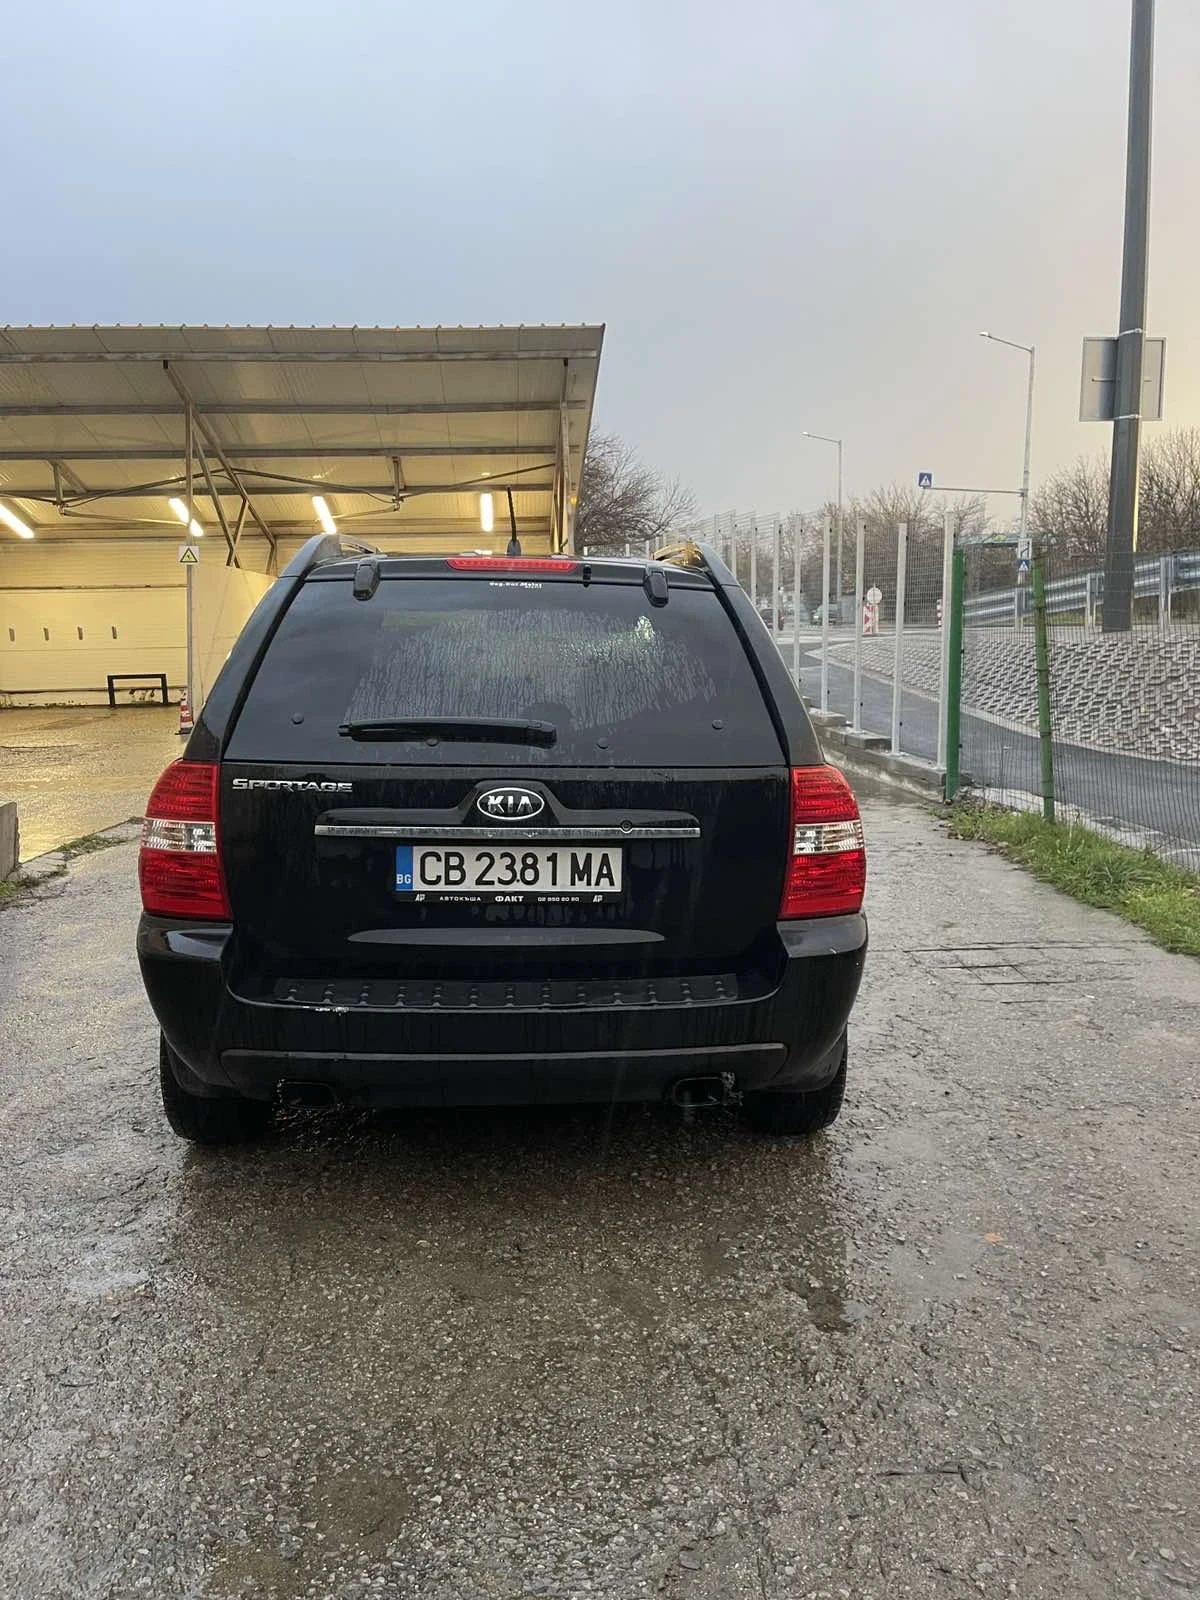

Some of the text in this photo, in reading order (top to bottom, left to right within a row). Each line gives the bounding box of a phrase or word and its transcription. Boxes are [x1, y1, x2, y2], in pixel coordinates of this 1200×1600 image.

[232, 778, 353, 793] SPORTAGE
[487, 795, 534, 812] KIA
[419, 851, 615, 887] CB 2381 MA
[396, 874, 412, 885] BG
[494, 895, 524, 903] ФАКТ
